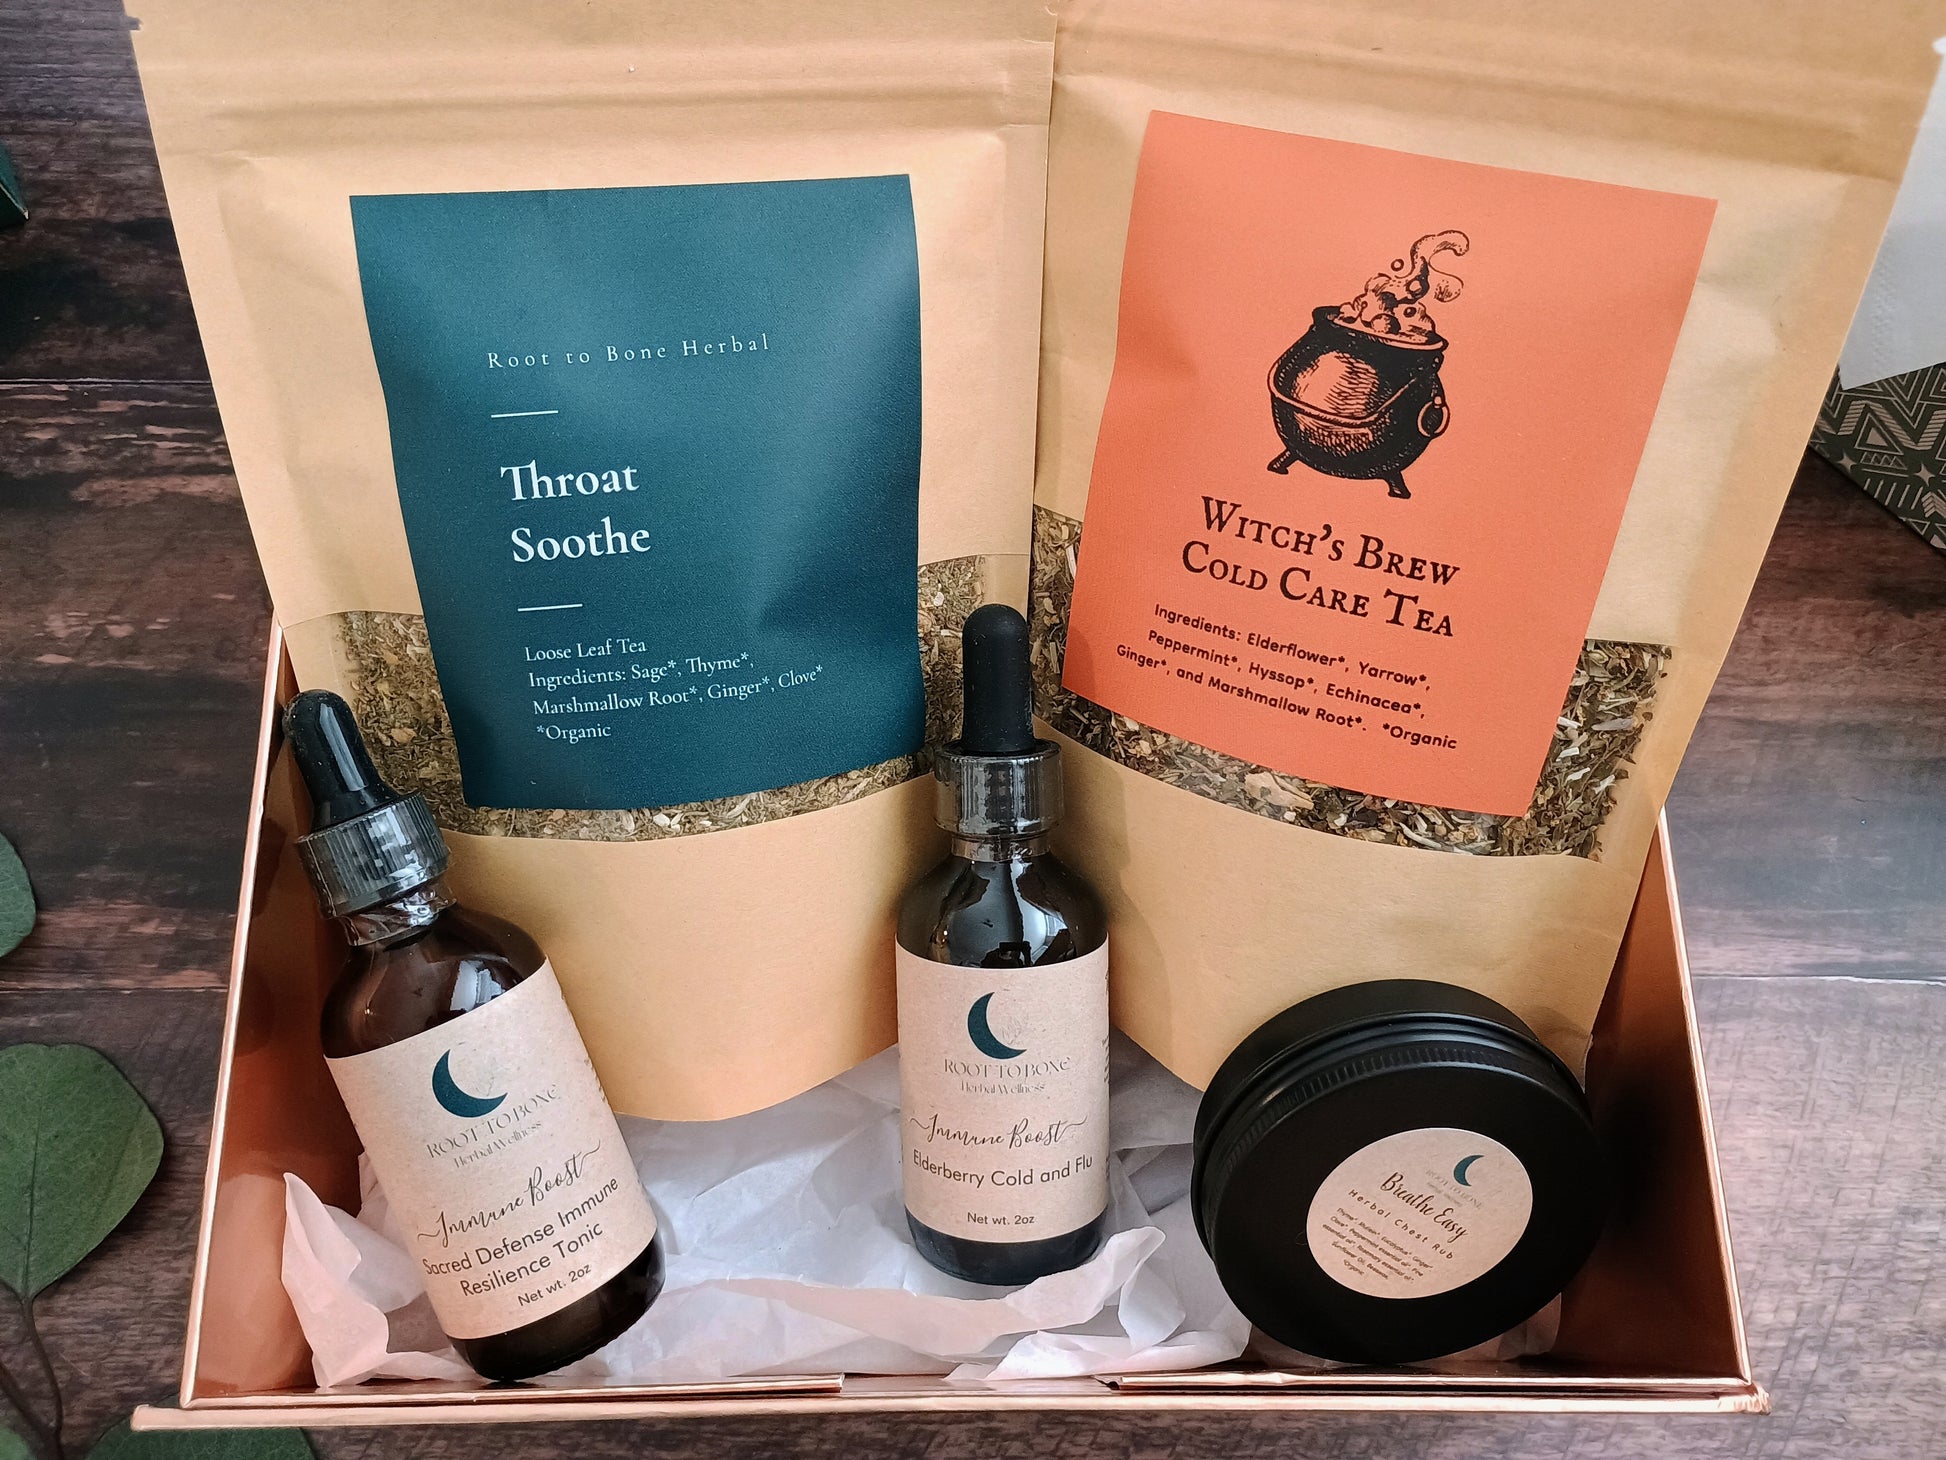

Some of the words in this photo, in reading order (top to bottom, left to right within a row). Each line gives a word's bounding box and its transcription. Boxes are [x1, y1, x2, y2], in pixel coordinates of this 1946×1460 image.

[488, 352, 550, 368] Root
[566, 350, 590, 365] to
[606, 345, 666, 362] Bone
[682, 333, 769, 357] Herbal
[500, 459, 640, 501] Throat
[511, 516, 651, 562] Soothe
[1154, 604, 1241, 642] Ingredients:
[525, 645, 572, 661] Loose
[576, 639, 612, 657] Leaf
[616, 638, 647, 654] Tea
[529, 669, 626, 691] Ingredients:
[1177, 667, 1203, 684] and
[1208, 676, 1309, 717] Marshmallow
[533, 693, 643, 715] Marshmallow
[944, 1059, 989, 1078] ROOT
[998, 1064, 1019, 1078] TO
[427, 1128, 478, 1158] ROOT
[482, 1112, 511, 1135] TO
[910, 1113, 1005, 1146] Immune
[1007, 1115, 1087, 1149] Boost
[913, 1149, 984, 1189] Elderberry
[991, 1169, 1033, 1186] Cold
[1040, 1161, 1070, 1183] and
[1075, 1155, 1093, 1173] Flu
[418, 1198, 524, 1248] Immune
[524, 1140, 600, 1206] Boost
[1380, 1172, 1434, 1215] Breathe
[1434, 1208, 1468, 1243] Easy
[422, 1253, 472, 1275] Sacred
[475, 1223, 555, 1264] Defense
[557, 1176, 618, 1228] Immune
[968, 1212, 988, 1224] Net
[992, 1215, 1010, 1226] wt.
[1014, 1215, 1035, 1224] 2oz
[1349, 1190, 1391, 1218] Herbal
[1395, 1219, 1428, 1242] Chest
[1432, 1244, 1453, 1259] Rub
[460, 1255, 551, 1296] Resilience
[553, 1222, 603, 1258] Tonic
[518, 1291, 544, 1306] Net
[545, 1282, 566, 1296] wt.
[568, 1264, 592, 1281] 2oz
